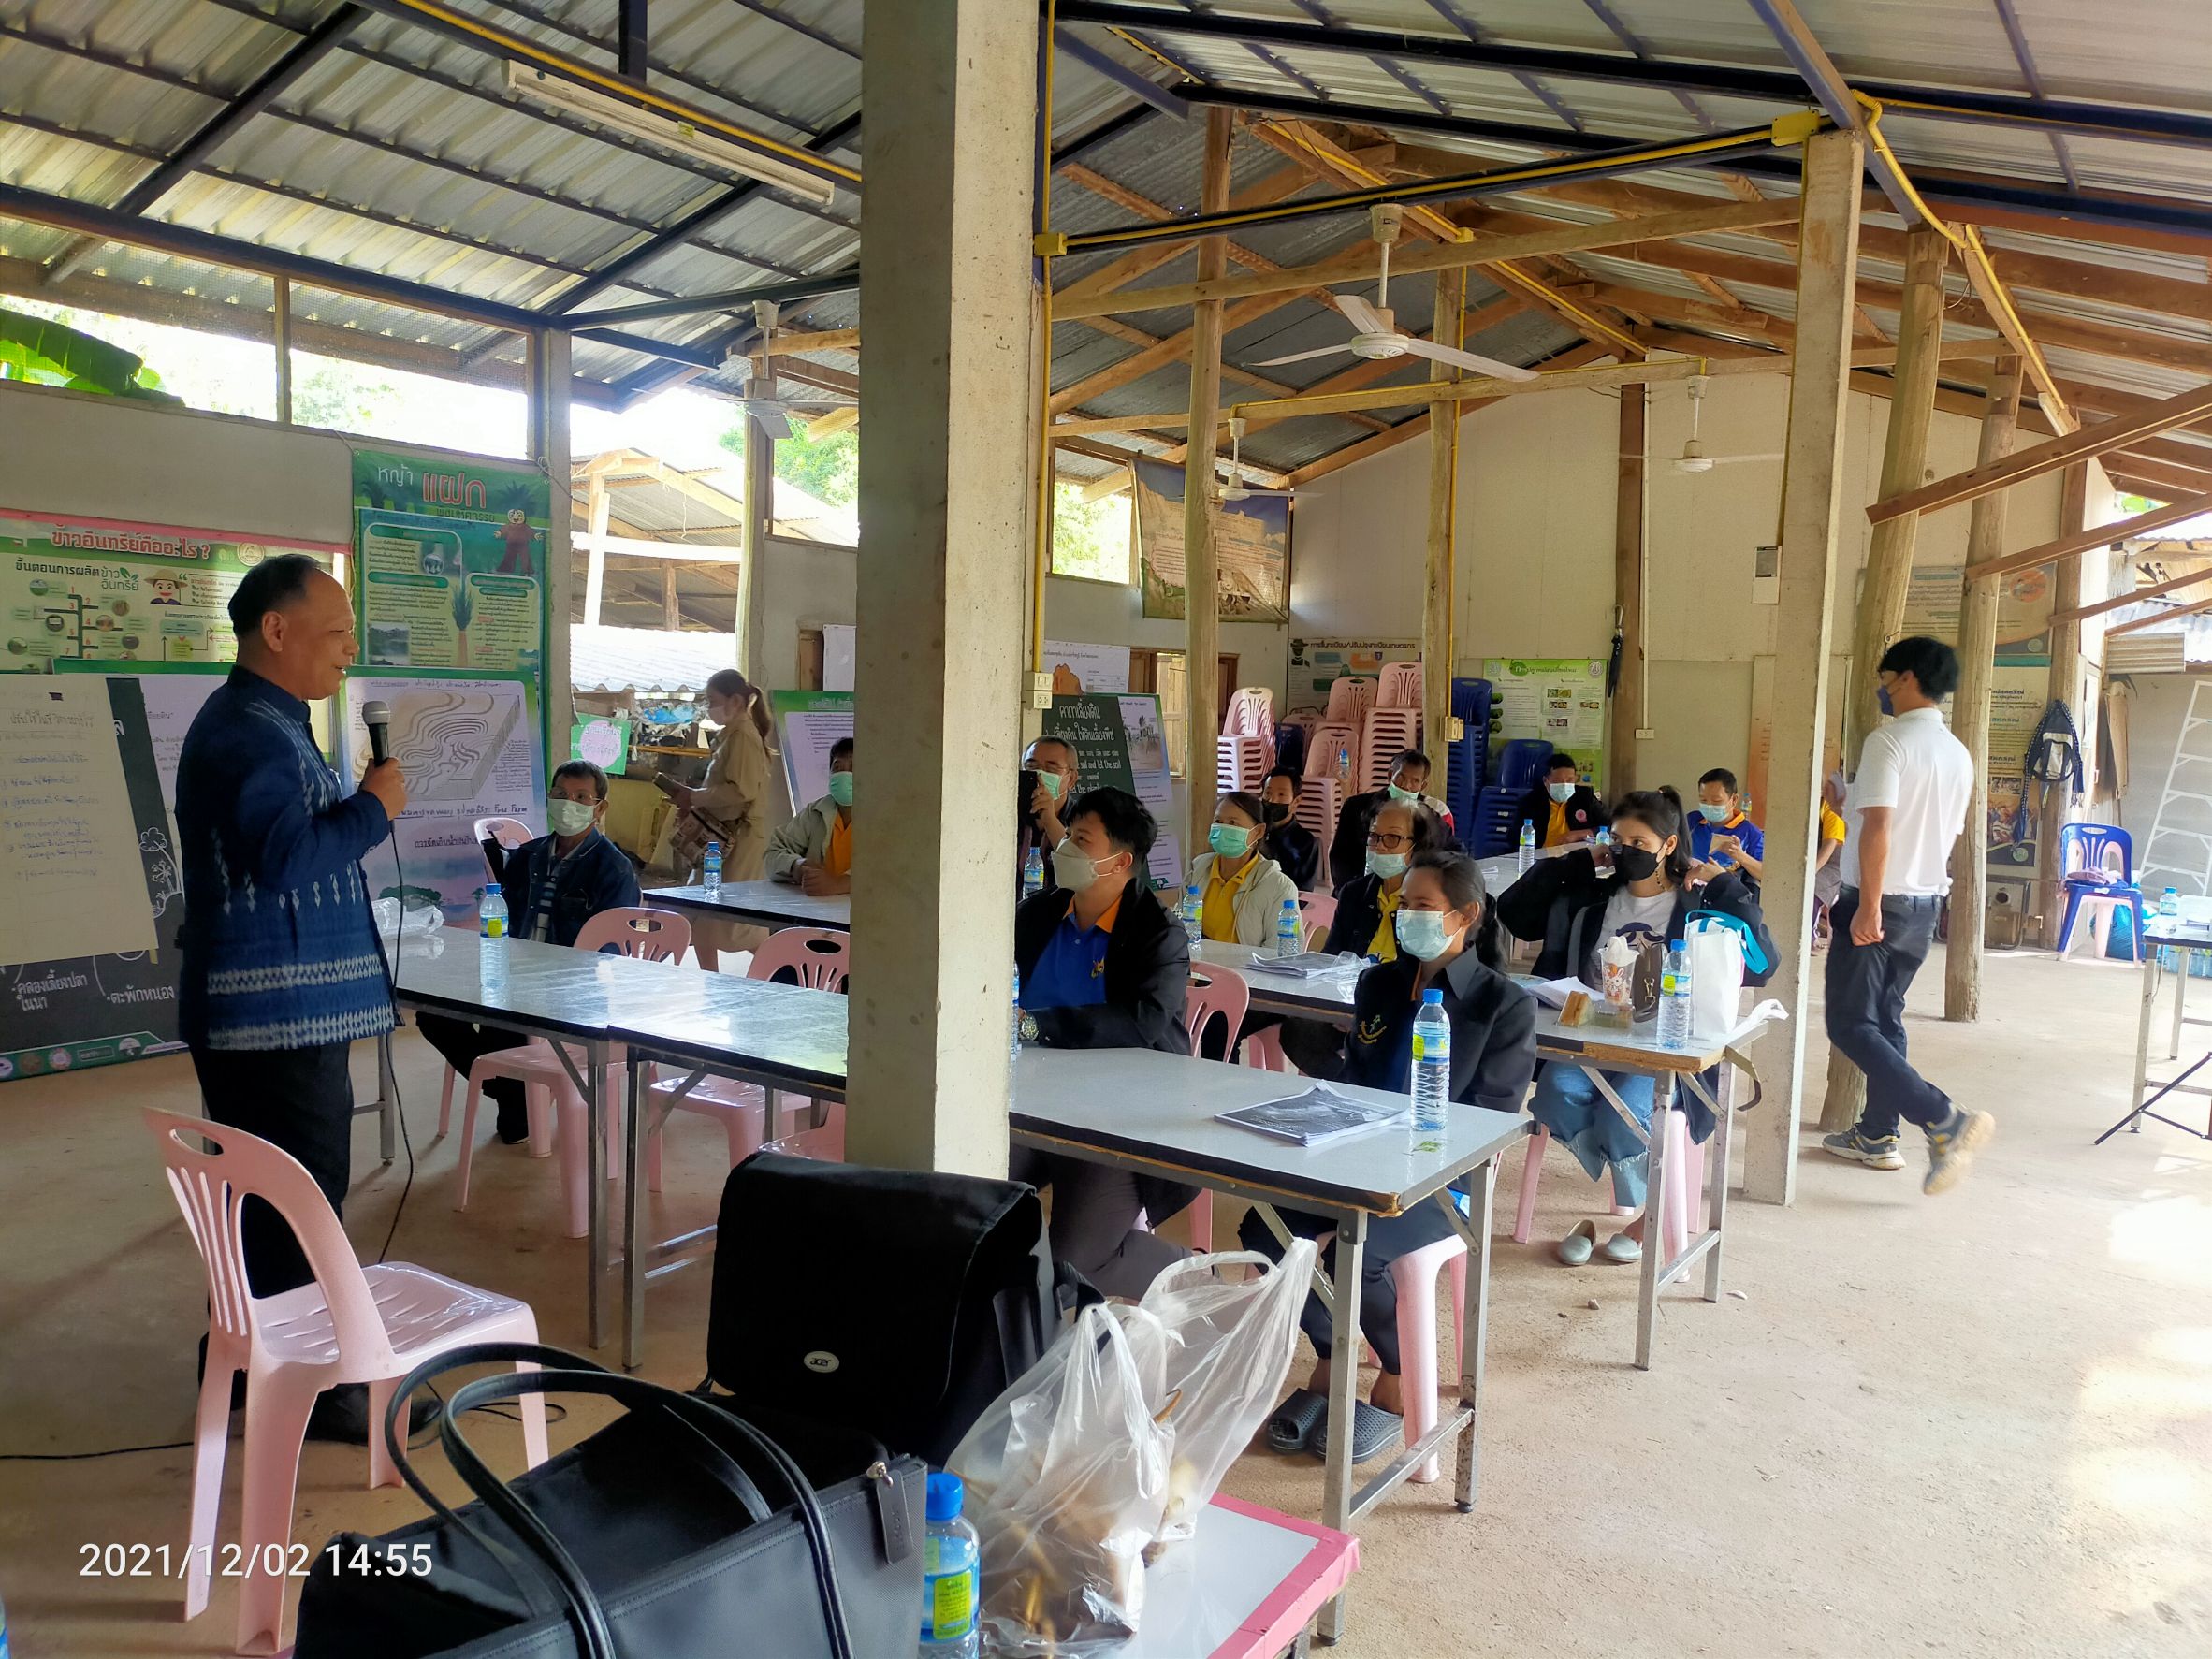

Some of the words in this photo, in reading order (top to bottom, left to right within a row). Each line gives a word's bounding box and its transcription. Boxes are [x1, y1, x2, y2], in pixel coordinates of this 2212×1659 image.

[377, 463, 414, 487] หญ้า
[422, 471, 487, 509] แฝก
[16, 994, 48, 1011] ในนา
